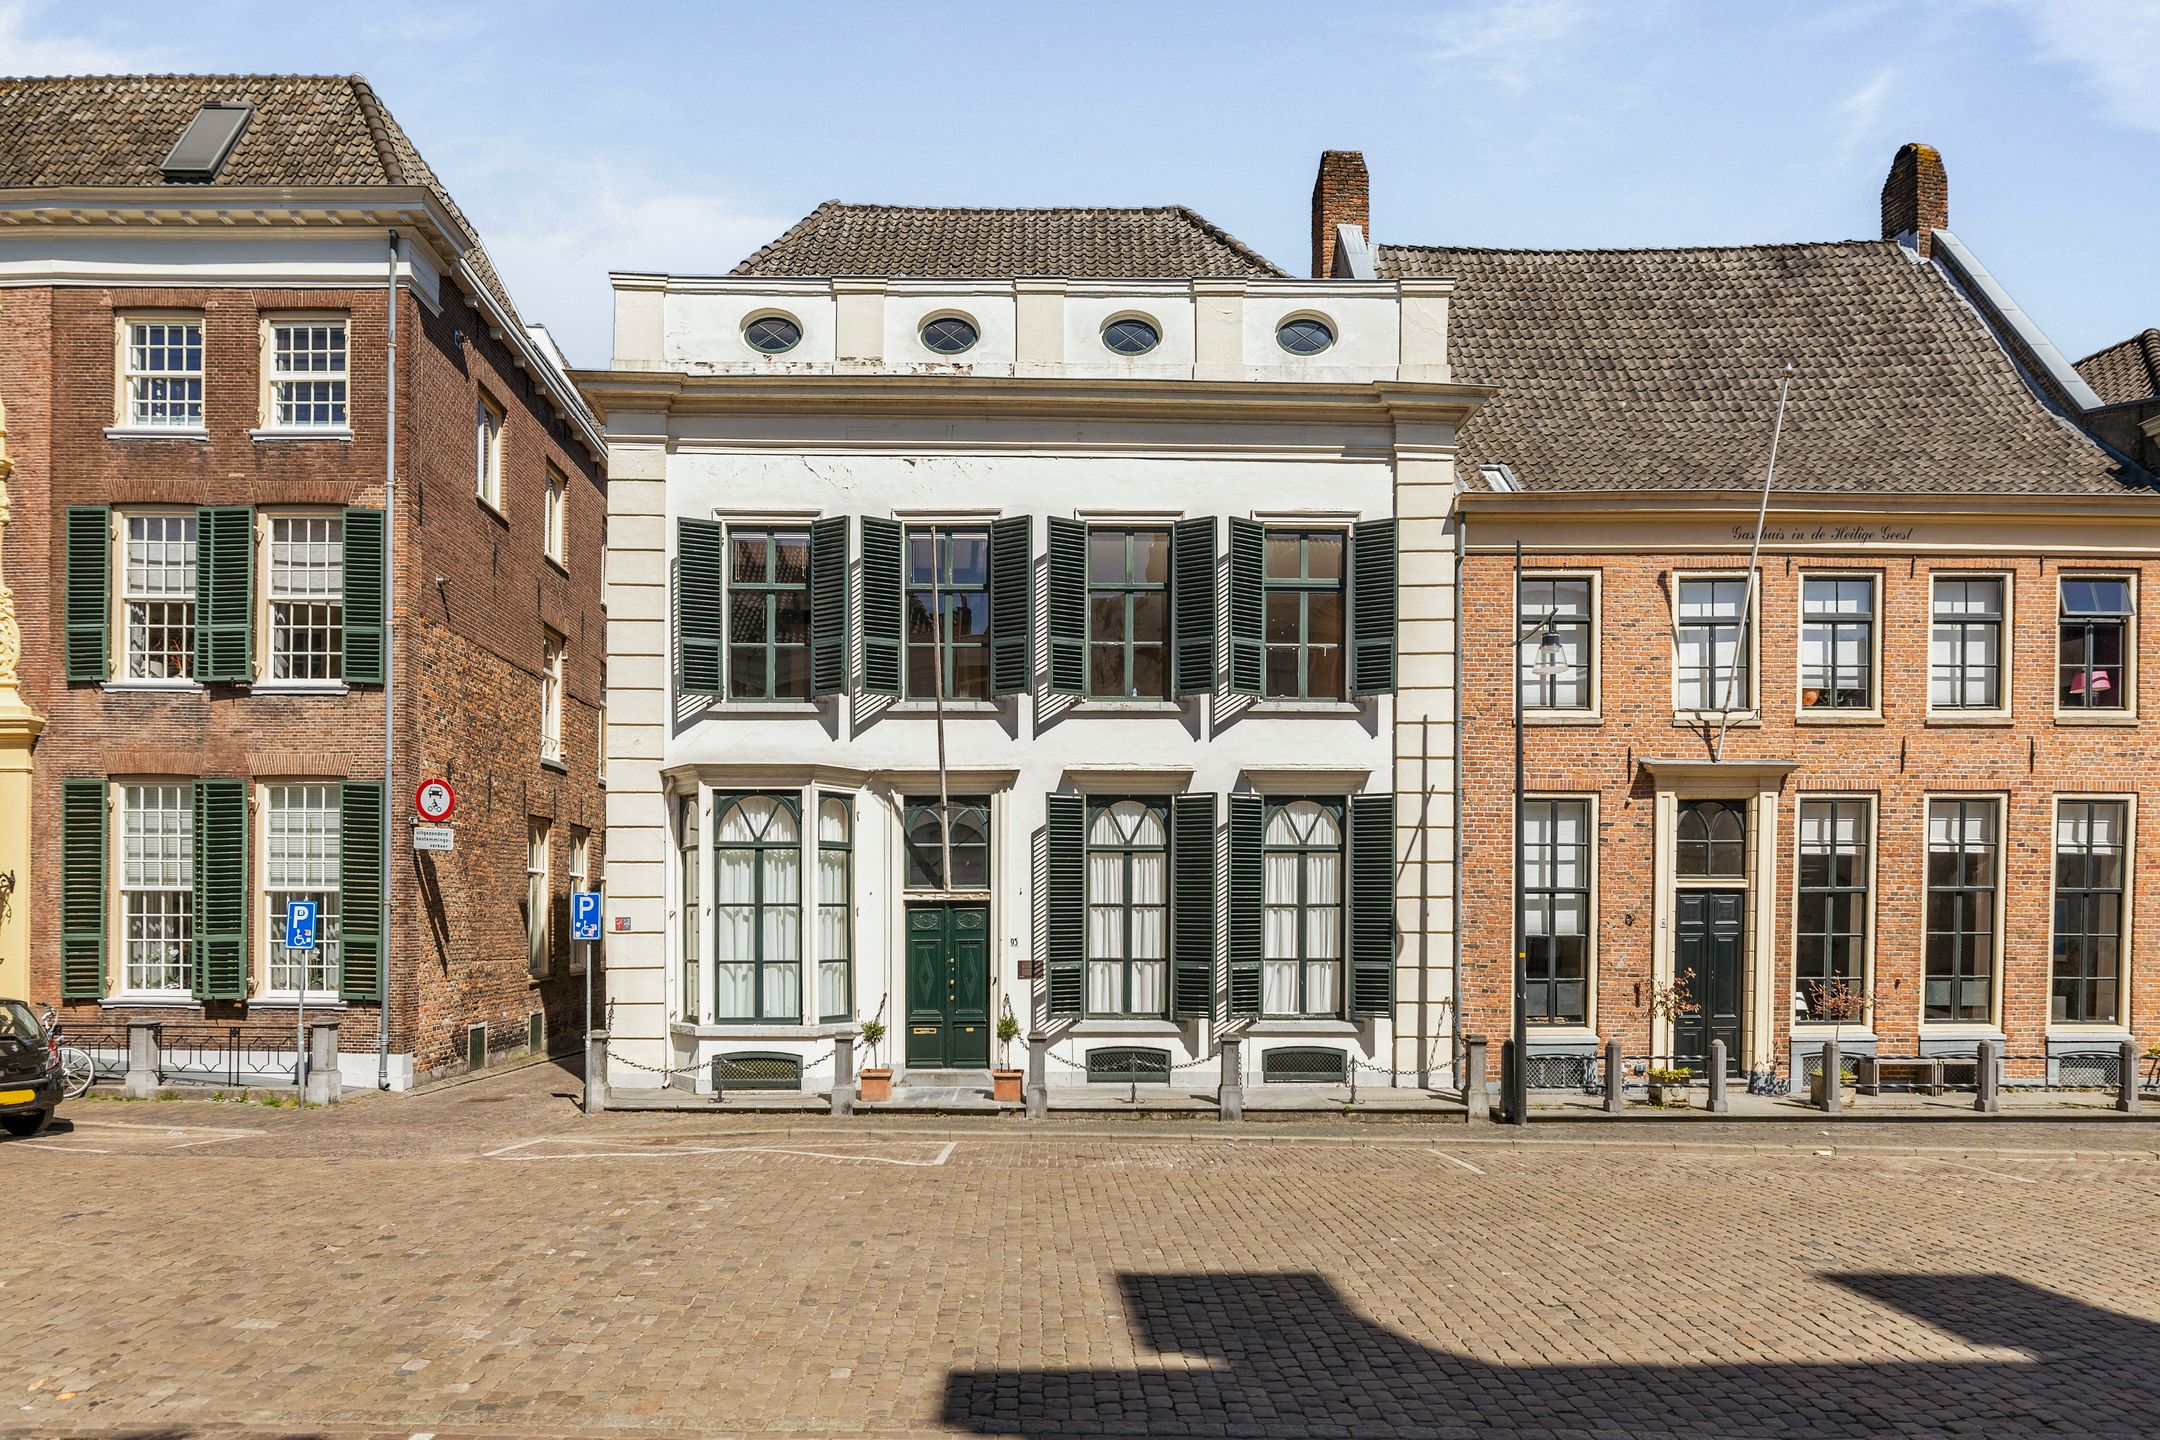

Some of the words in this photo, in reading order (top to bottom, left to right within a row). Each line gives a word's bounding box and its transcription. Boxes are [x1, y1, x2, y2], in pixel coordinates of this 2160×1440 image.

[1731, 525, 1785, 540] Gashuis
[1792, 528, 1804, 540] in
[1811, 526, 1826, 540] de
[1831, 526, 1875, 545] Heilige
[1880, 525, 1914, 540] Geest
[293, 906, 309, 928] P
[580, 897, 594, 919] P
